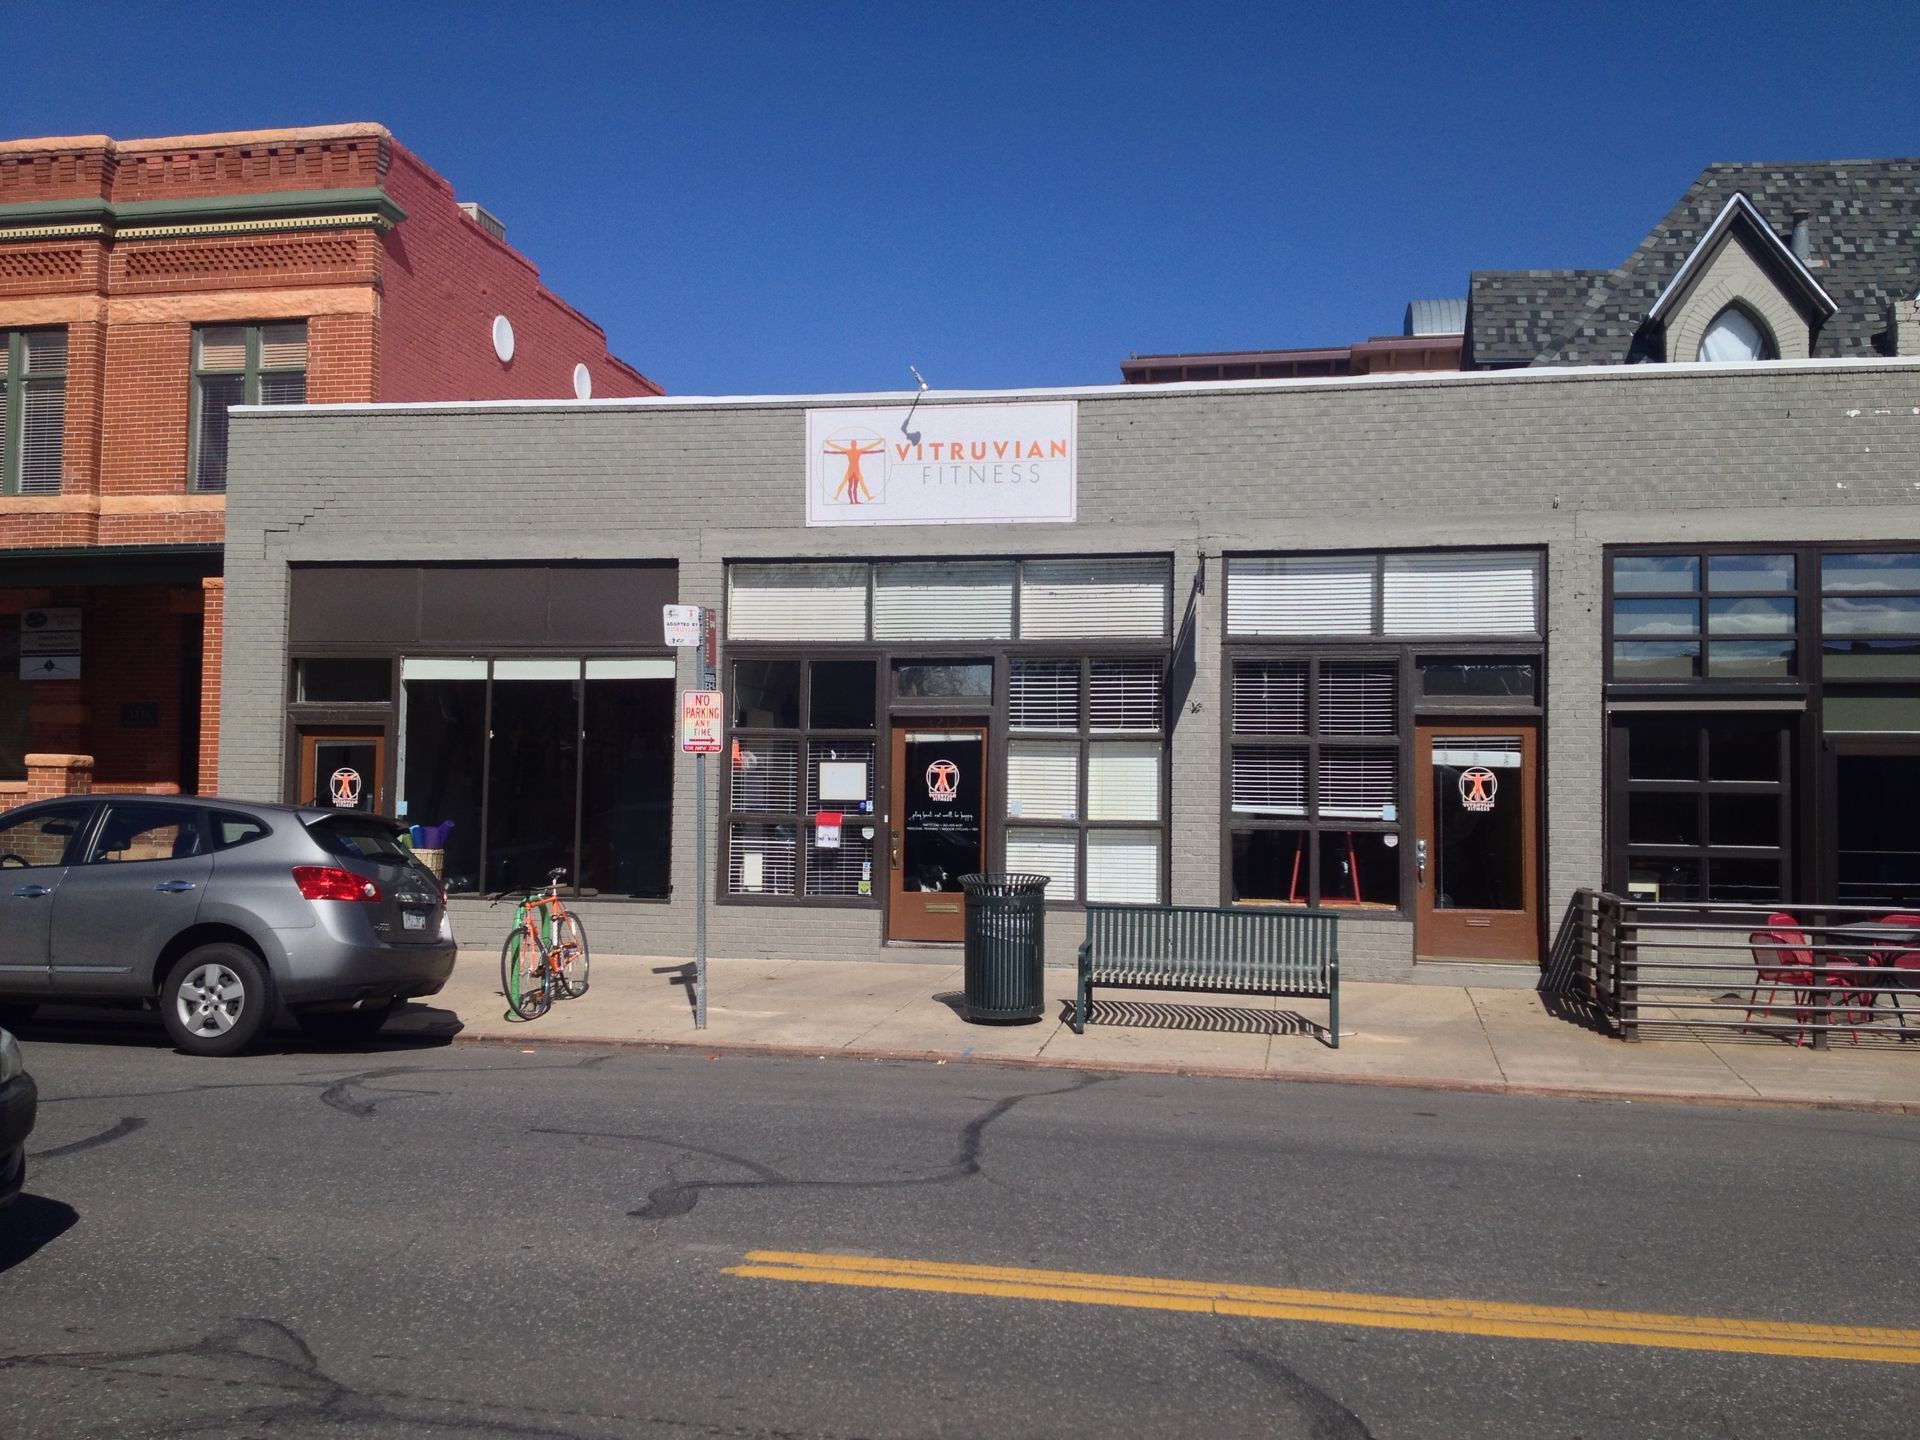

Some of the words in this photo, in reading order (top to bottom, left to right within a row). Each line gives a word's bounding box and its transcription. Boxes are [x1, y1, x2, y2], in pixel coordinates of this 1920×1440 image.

[895, 439, 1067, 462] VITRUVIAN
[922, 463, 1041, 485] FITNESS
[695, 694, 710, 706] NO
[686, 707, 720, 719] PARKING
[694, 719, 710, 727] ANY
[693, 728, 712, 736] TIME
